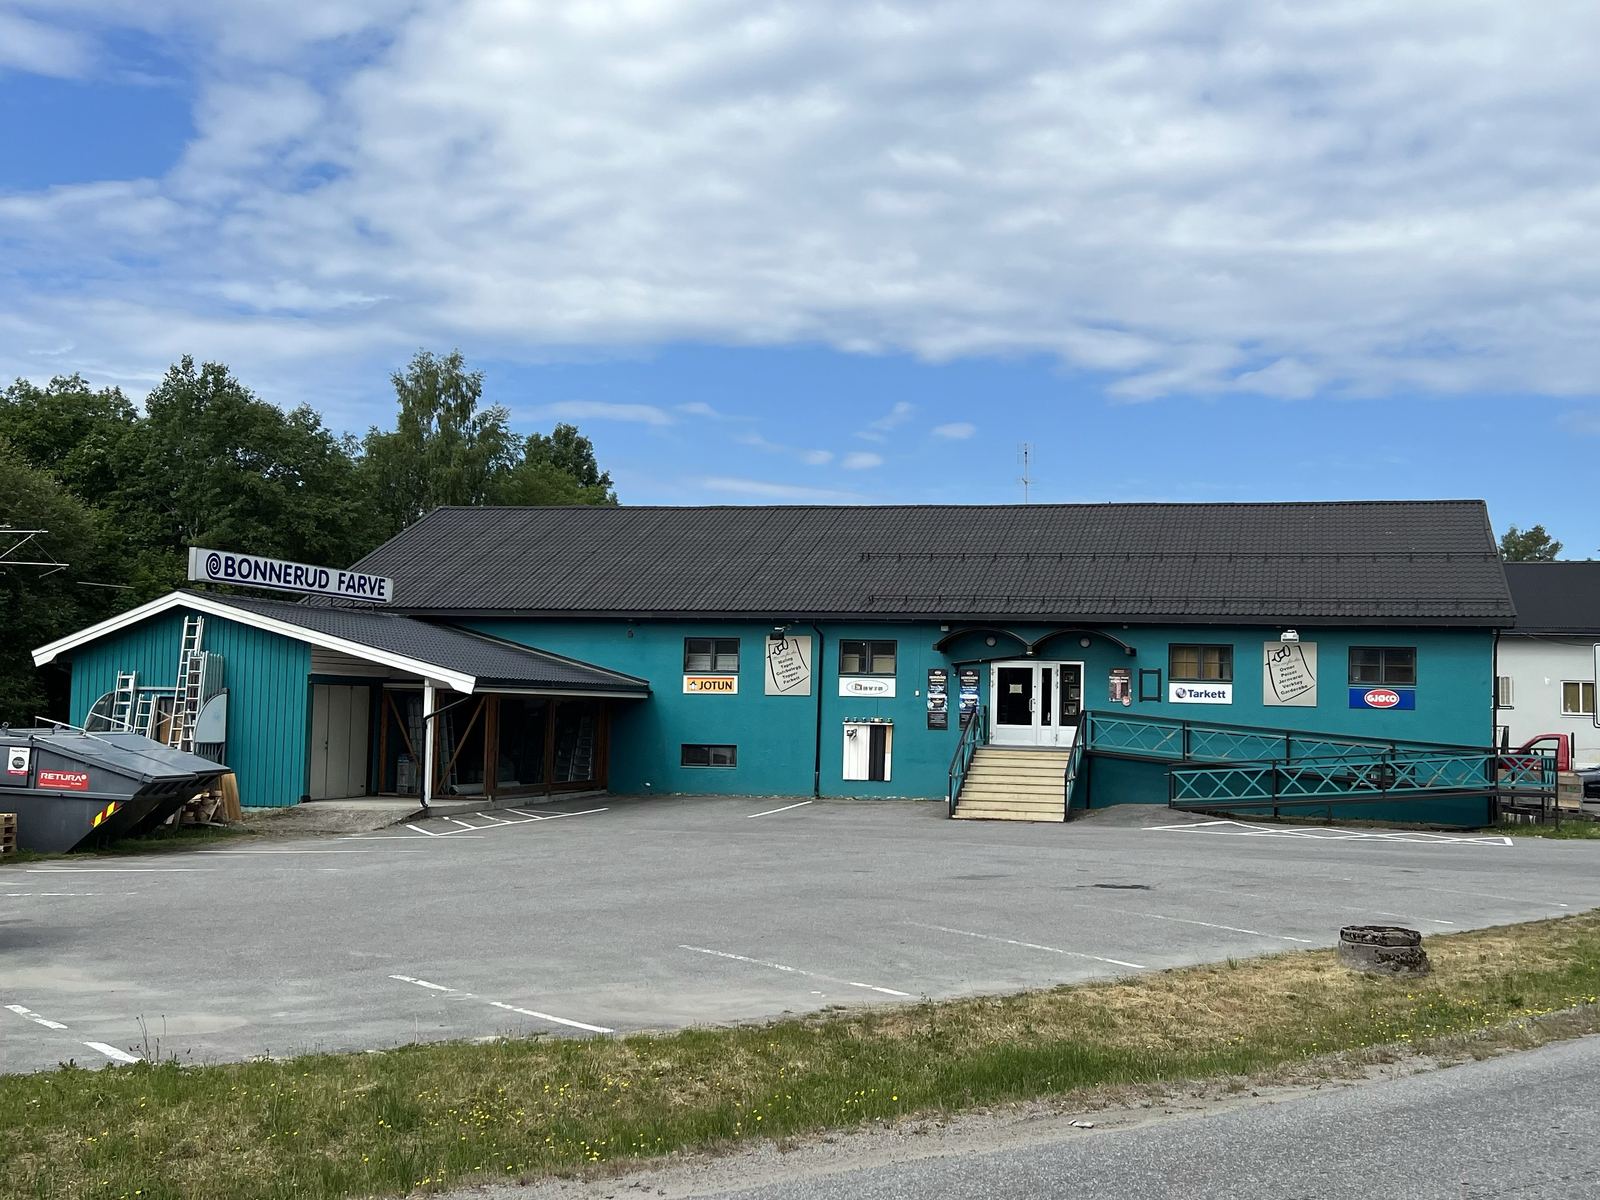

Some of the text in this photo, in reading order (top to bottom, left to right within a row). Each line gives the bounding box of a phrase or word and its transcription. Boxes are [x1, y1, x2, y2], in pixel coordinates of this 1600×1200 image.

[224, 556, 386, 597] BONNERUD FARVE
[699, 681, 733, 691] JOTUN
[1188, 689, 1226, 699] Tarkett
[1366, 694, 1398, 703] GJØCO
[40, 772, 83, 782] RETURA
